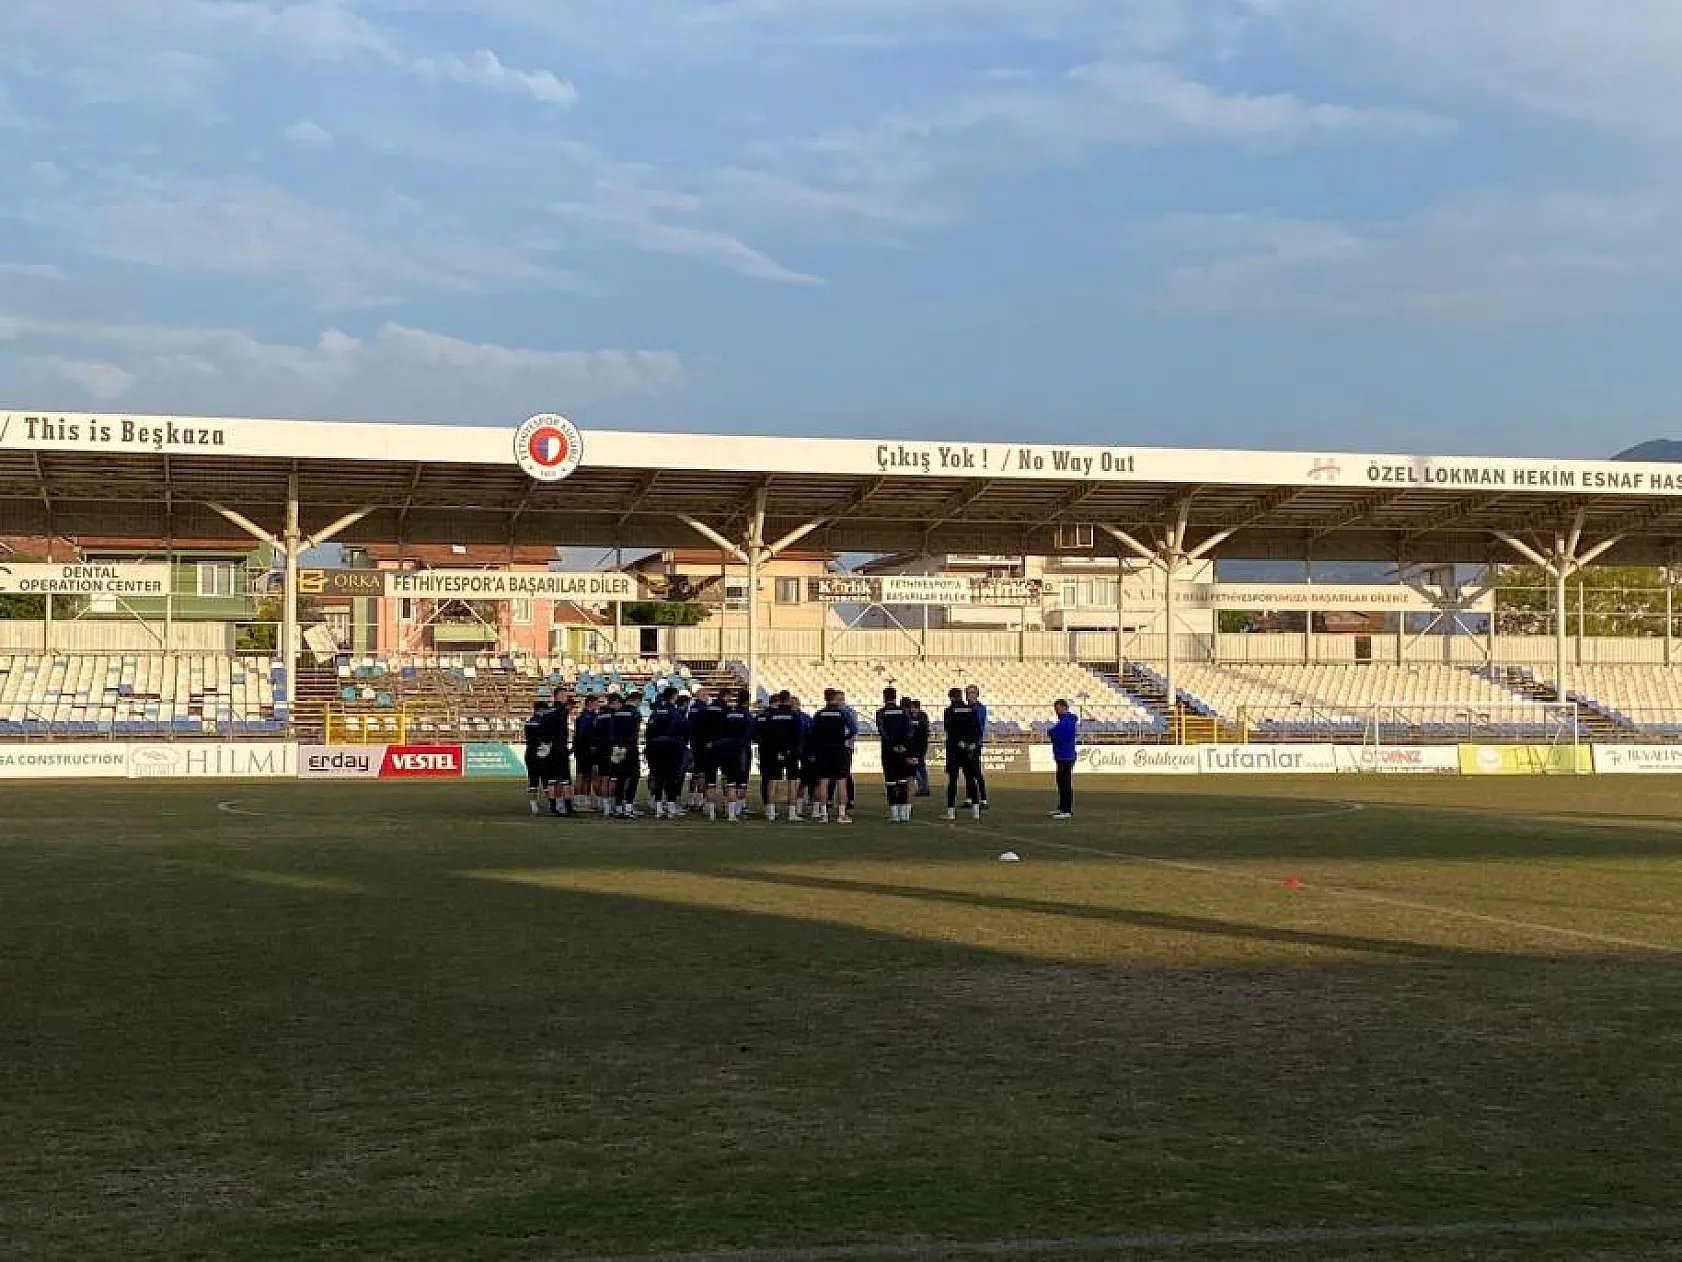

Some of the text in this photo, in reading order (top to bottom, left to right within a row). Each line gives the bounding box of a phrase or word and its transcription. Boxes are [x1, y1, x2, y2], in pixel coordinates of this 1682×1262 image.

[24, 417, 80, 441] This
[89, 418, 111, 442] is
[121, 420, 225, 450] Beşkaza
[876, 444, 931, 473] Çıkış
[937, 446, 975, 468] Yok
[1018, 449, 1044, 470] No
[1052, 450, 1094, 476] Way
[1101, 452, 1135, 473] Out
[1366, 460, 1419, 483] ÖZEL
[1424, 466, 1506, 485] LOKMAN
[1513, 465, 1575, 487] HEKİM
[1581, 471, 1644, 489] ESNAF
[62, 566, 120, 579] DENTAL
[333, 573, 380, 588] ORKA
[19, 579, 162, 592] OPERATION CENTER
[393, 573, 629, 595] FETHİYESPOR'A BAŞARILAR DİLER
[18, 753, 124, 766] CONSTRUCTION
[308, 751, 369, 772] erday
[391, 753, 457, 770] VESTEL
[1206, 748, 1304, 768] Tufanlar
